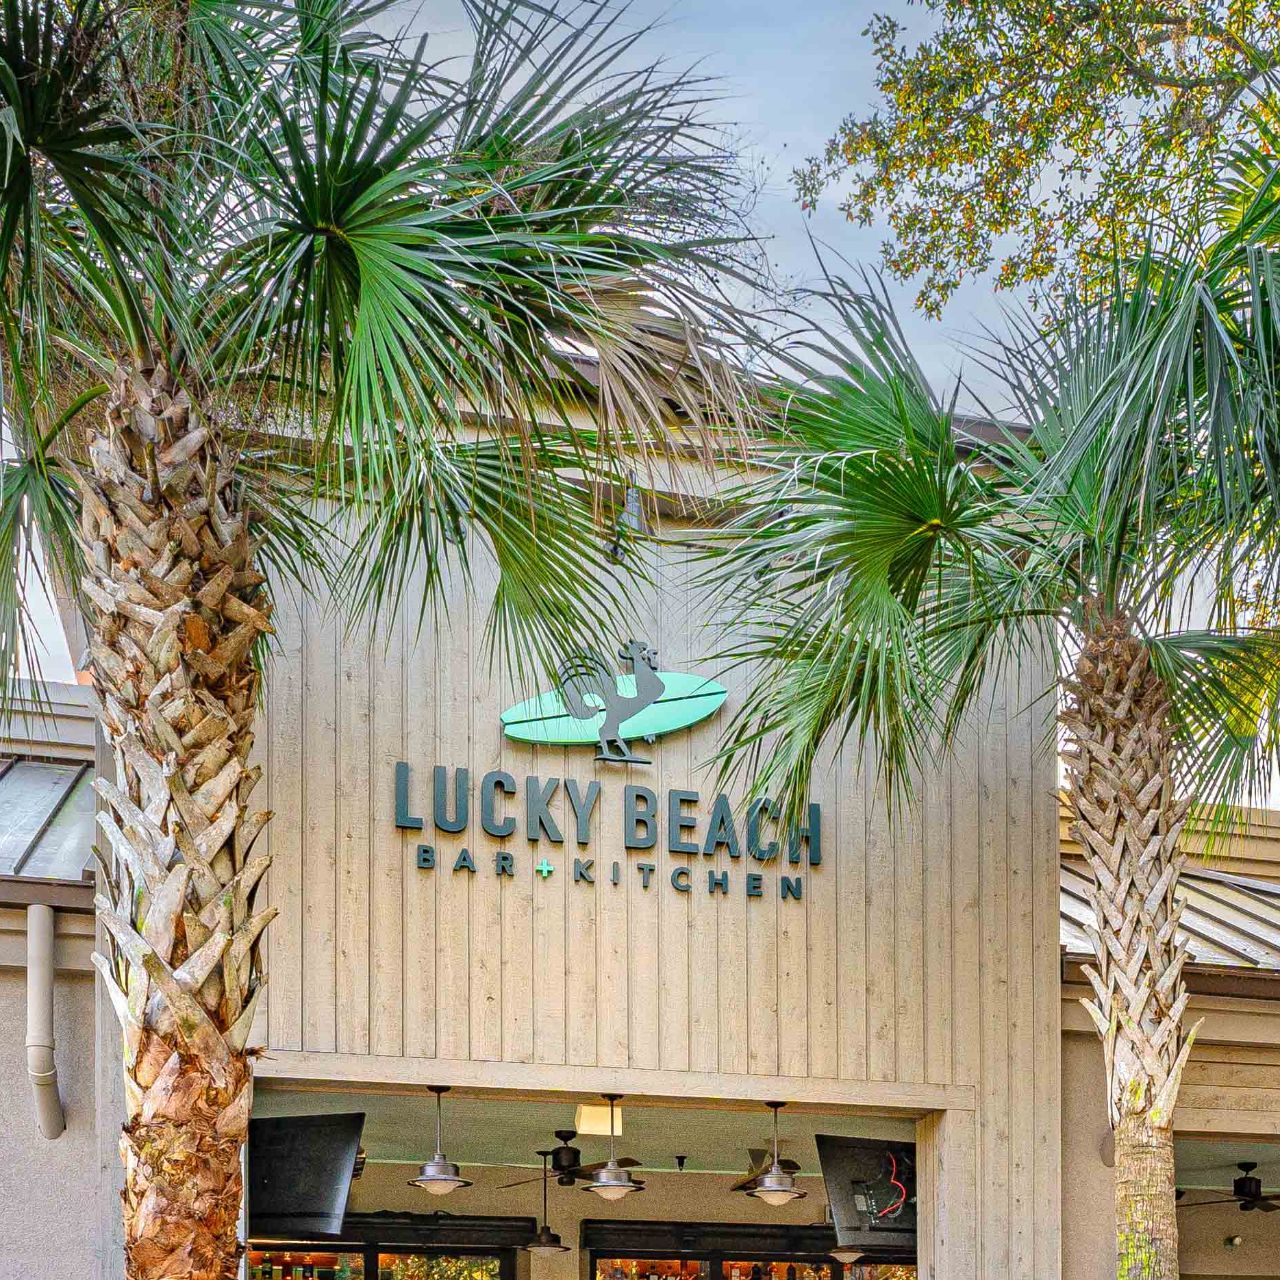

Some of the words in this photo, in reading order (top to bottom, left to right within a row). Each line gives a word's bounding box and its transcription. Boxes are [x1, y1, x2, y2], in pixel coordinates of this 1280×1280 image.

[395, 761, 601, 845] LUCKY
[624, 785, 822, 865] BEACH
[417, 844, 514, 876] BAR
[574, 858, 802, 900] KITCHEN
